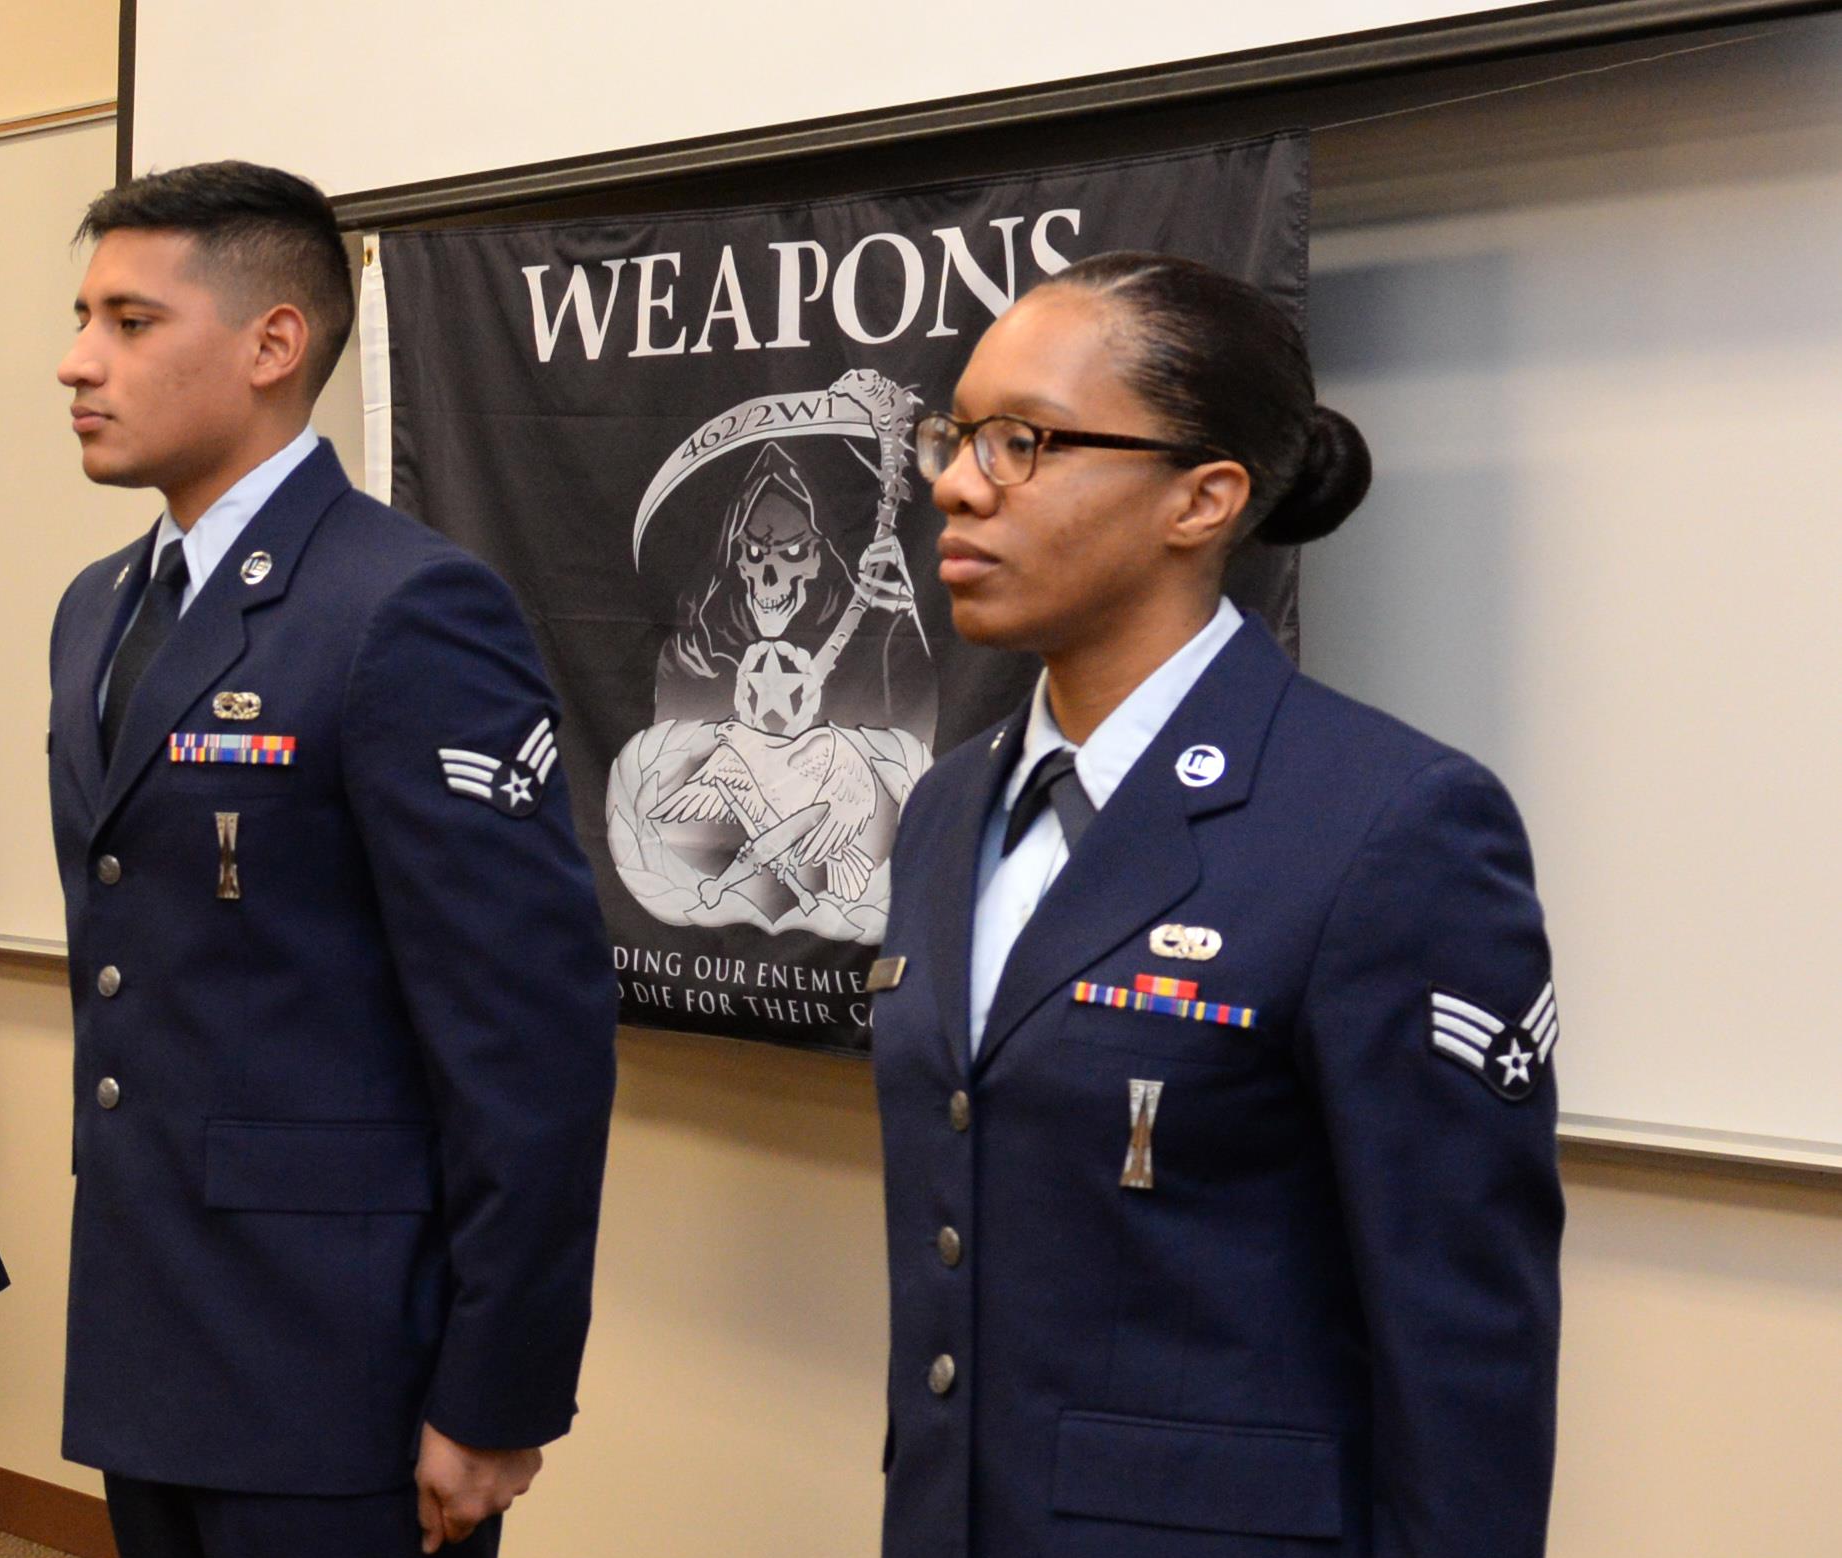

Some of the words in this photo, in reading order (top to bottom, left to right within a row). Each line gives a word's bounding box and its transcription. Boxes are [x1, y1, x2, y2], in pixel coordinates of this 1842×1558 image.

[613, 946, 682, 977] DING
[694, 955, 746, 985] OUR
[633, 981, 674, 1009] DIE
[685, 988, 736, 1016] FOR
[743, 995, 838, 1025] THEIR
